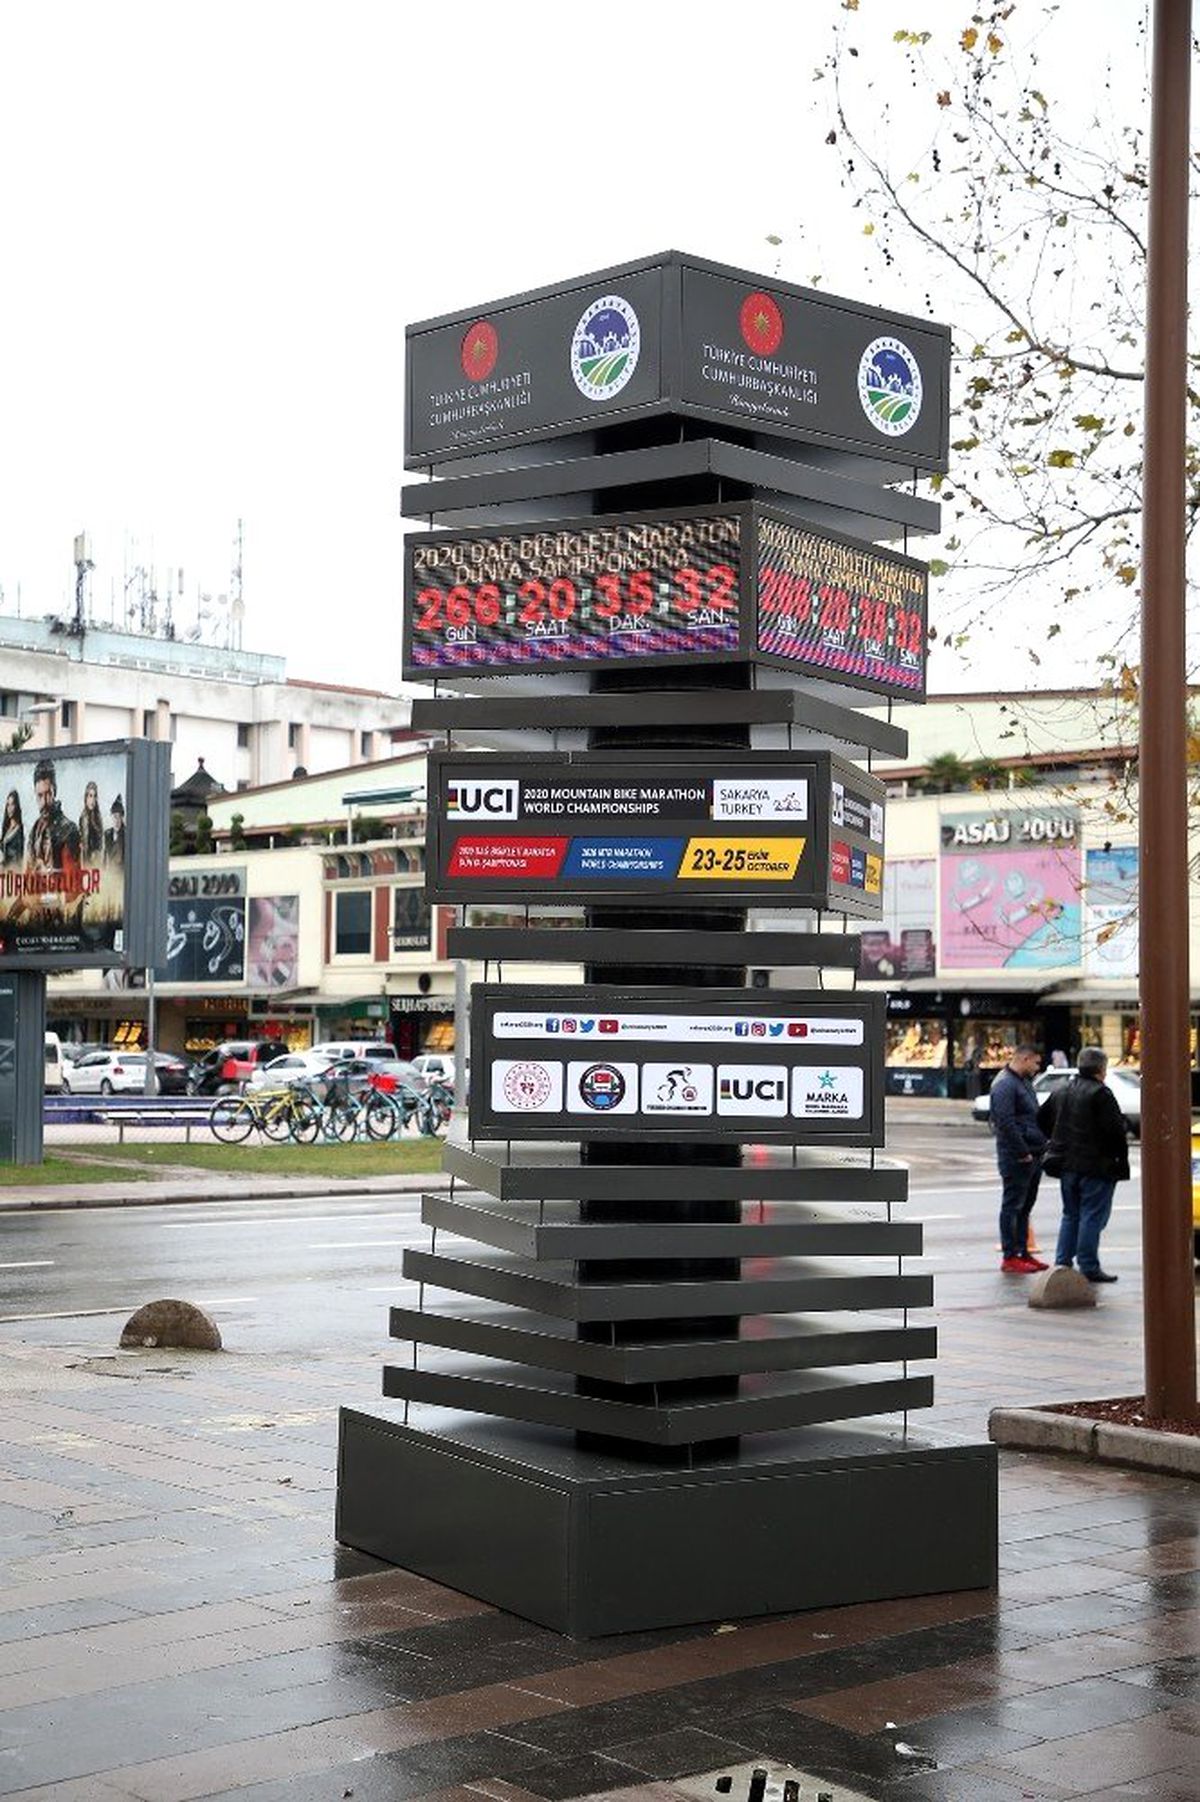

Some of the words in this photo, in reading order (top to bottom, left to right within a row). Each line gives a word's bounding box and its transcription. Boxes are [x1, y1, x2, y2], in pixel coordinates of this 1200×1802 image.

[413, 546, 464, 570] 2020
[525, 620, 568, 637] SAAT
[460, 787, 513, 813] UCI
[523, 788, 549, 800] 2020
[550, 788, 612, 800] MOUNTAIN
[613, 788, 638, 800] BIKE
[640, 789, 706, 801] MARATHON
[719, 788, 771, 801] SAKARYA
[523, 802, 564, 814] WORLD
[566, 802, 660, 814] CHAMPIONSHIPS
[719, 803, 764, 815] TURKEY
[692, 848, 746, 872] 23-25
[747, 862, 791, 873] OCTOBER
[733, 1079, 784, 1101] UCI
[805, 1092, 849, 1103] MARKA
